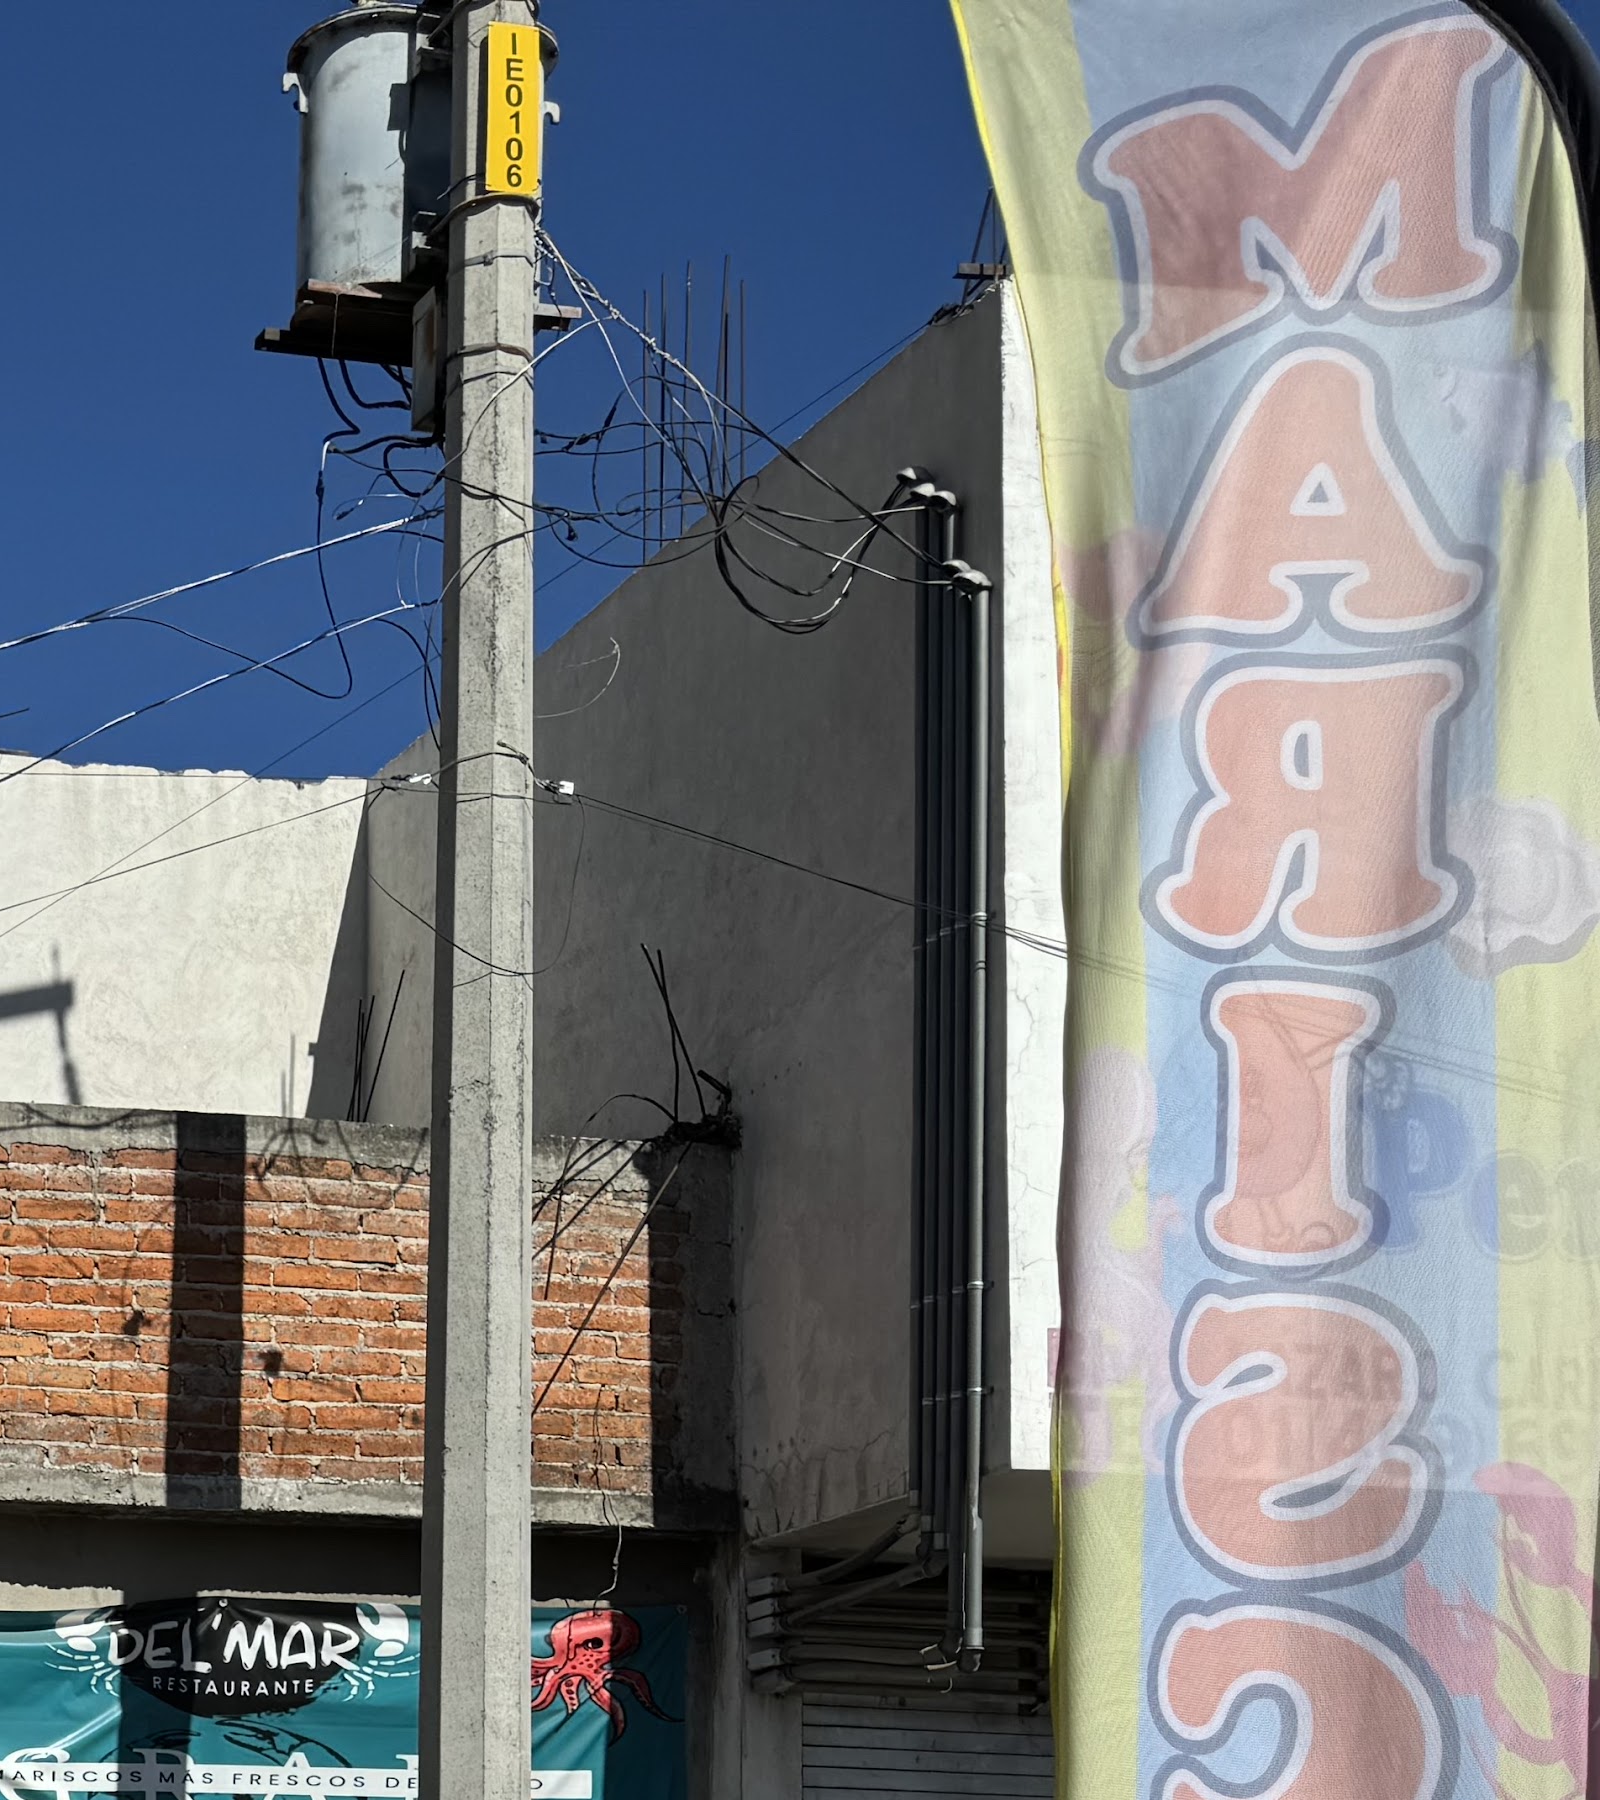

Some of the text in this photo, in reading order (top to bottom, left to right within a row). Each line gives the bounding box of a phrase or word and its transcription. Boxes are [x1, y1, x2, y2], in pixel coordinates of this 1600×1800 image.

[152, 1675, 315, 1697] RESTAURANTE
[158, 1767, 214, 1785] MÁS
[231, 1772, 366, 1789] FRESCOS
